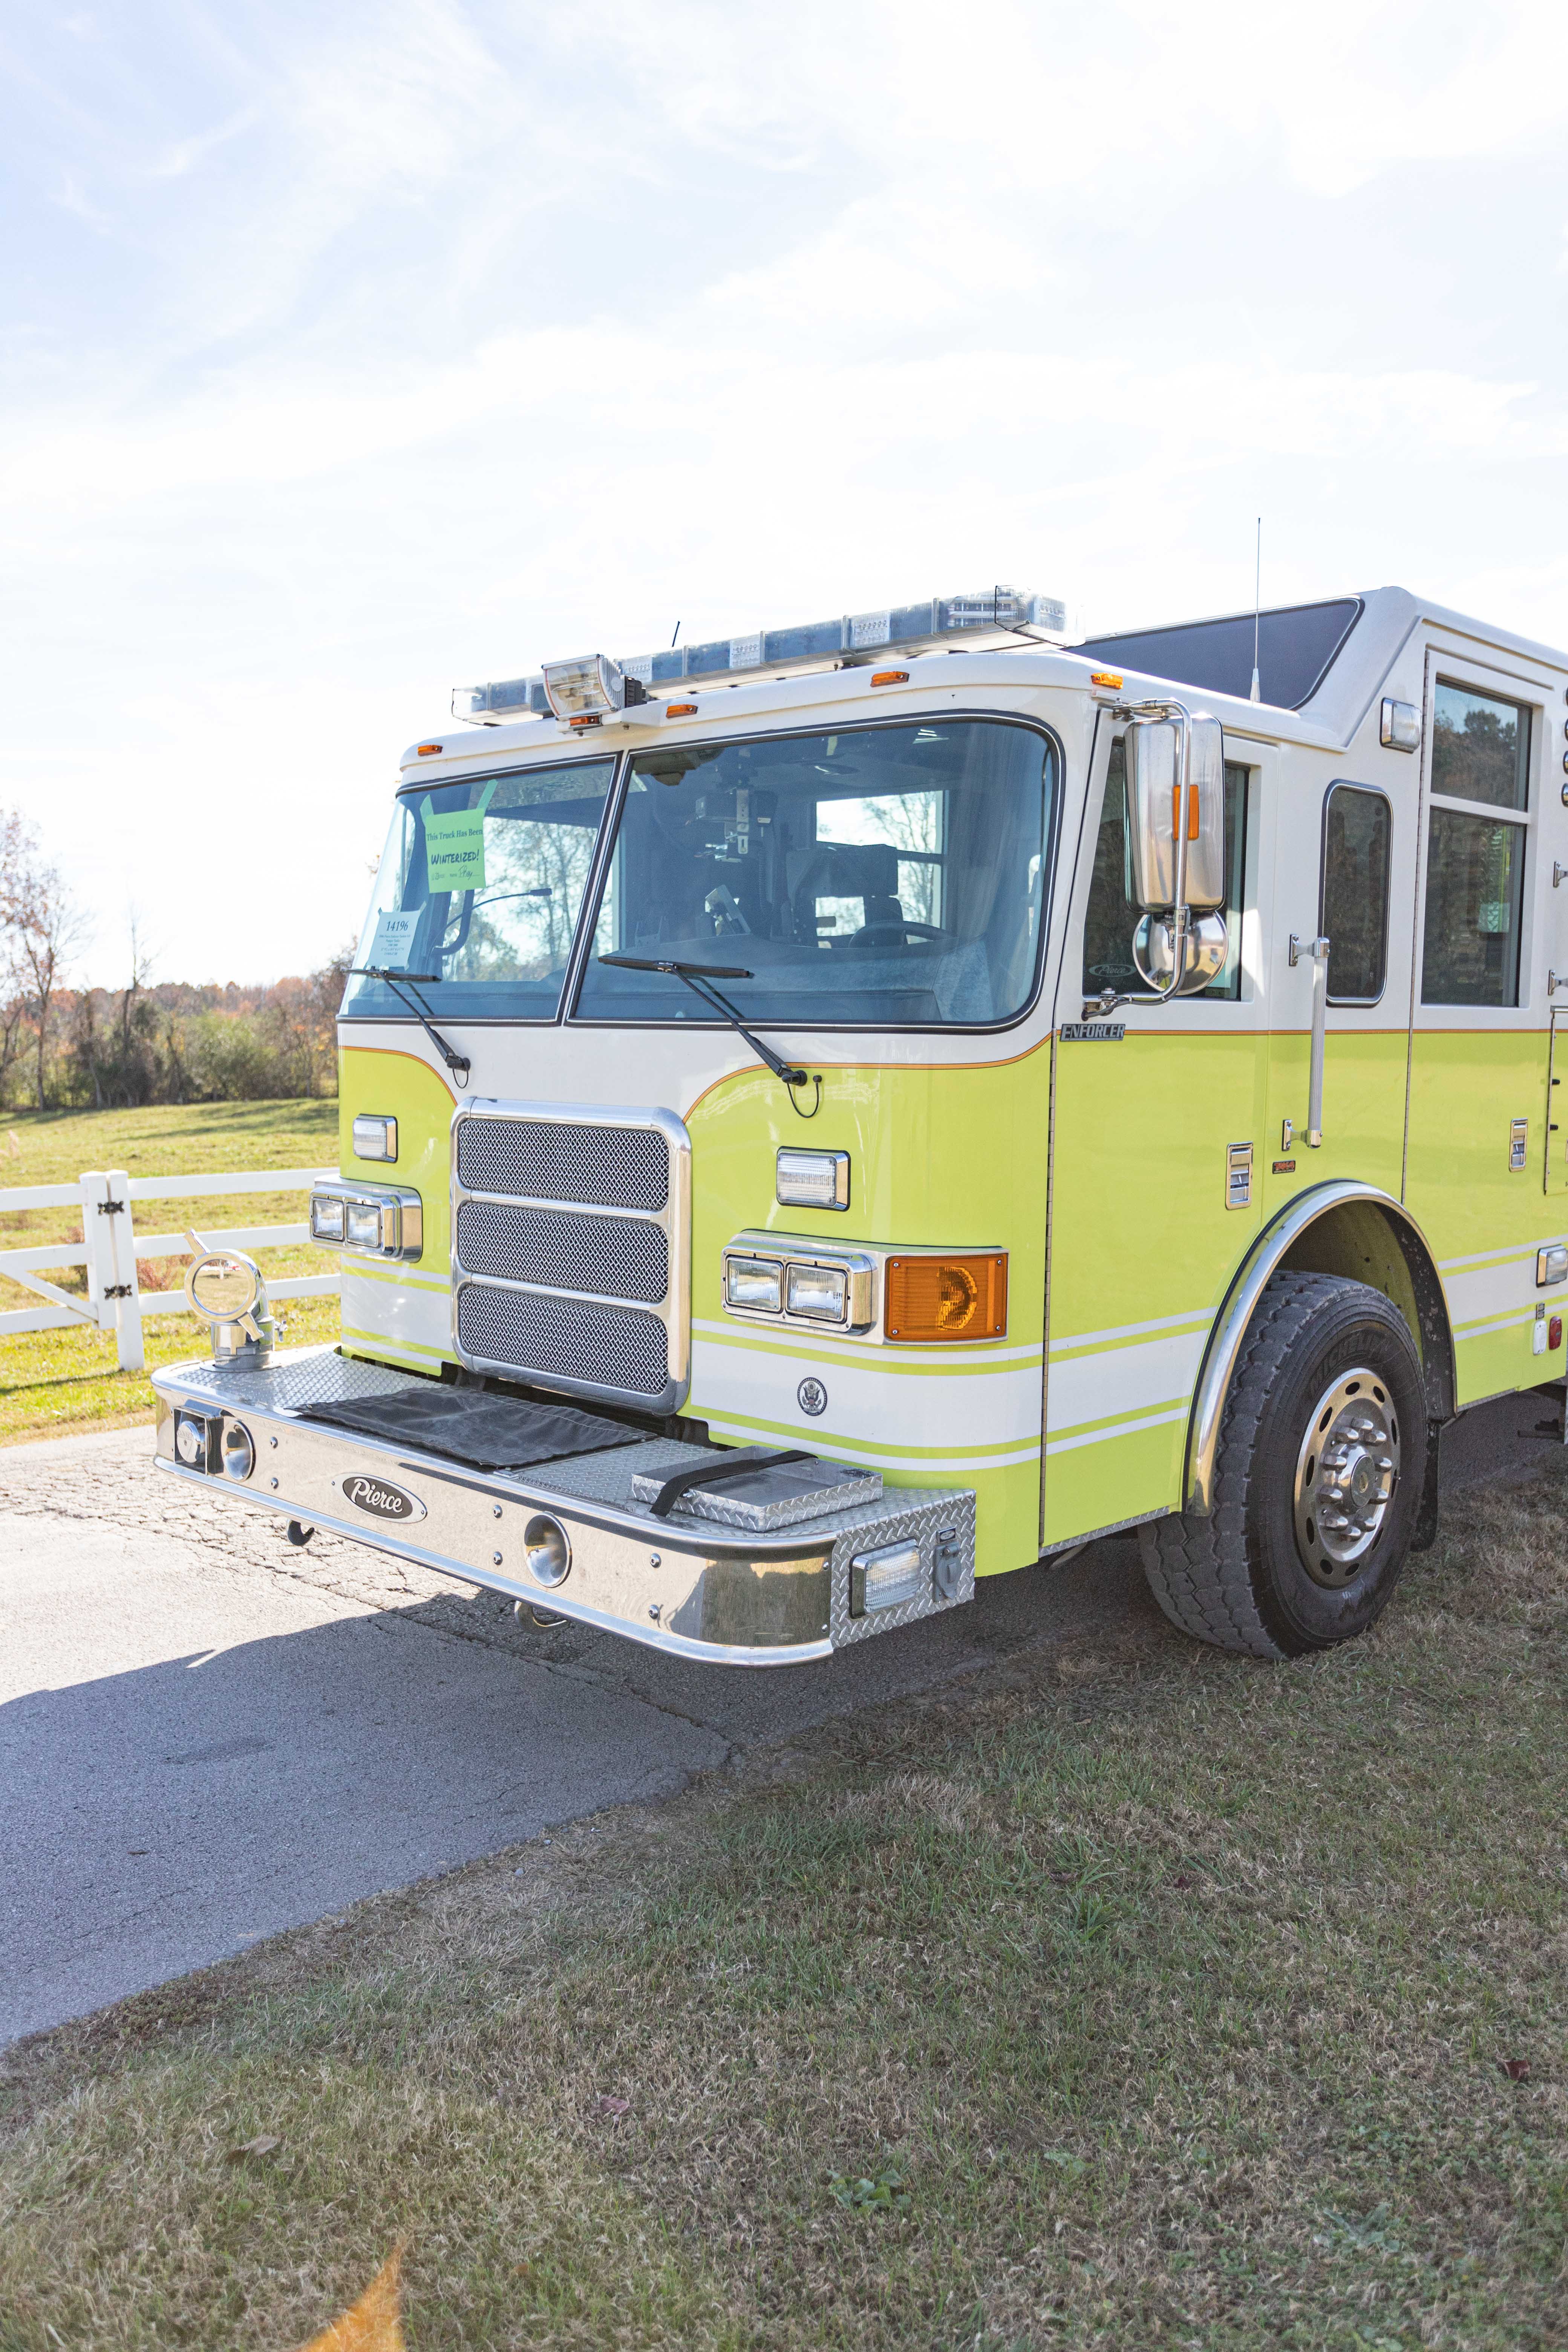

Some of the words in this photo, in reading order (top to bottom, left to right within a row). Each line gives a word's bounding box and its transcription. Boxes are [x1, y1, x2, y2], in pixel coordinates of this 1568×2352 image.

[386, 920, 409, 931] 14196
[1061, 1024, 1125, 1039] ENFORCER
[351, 1478, 403, 1513] Pierce
